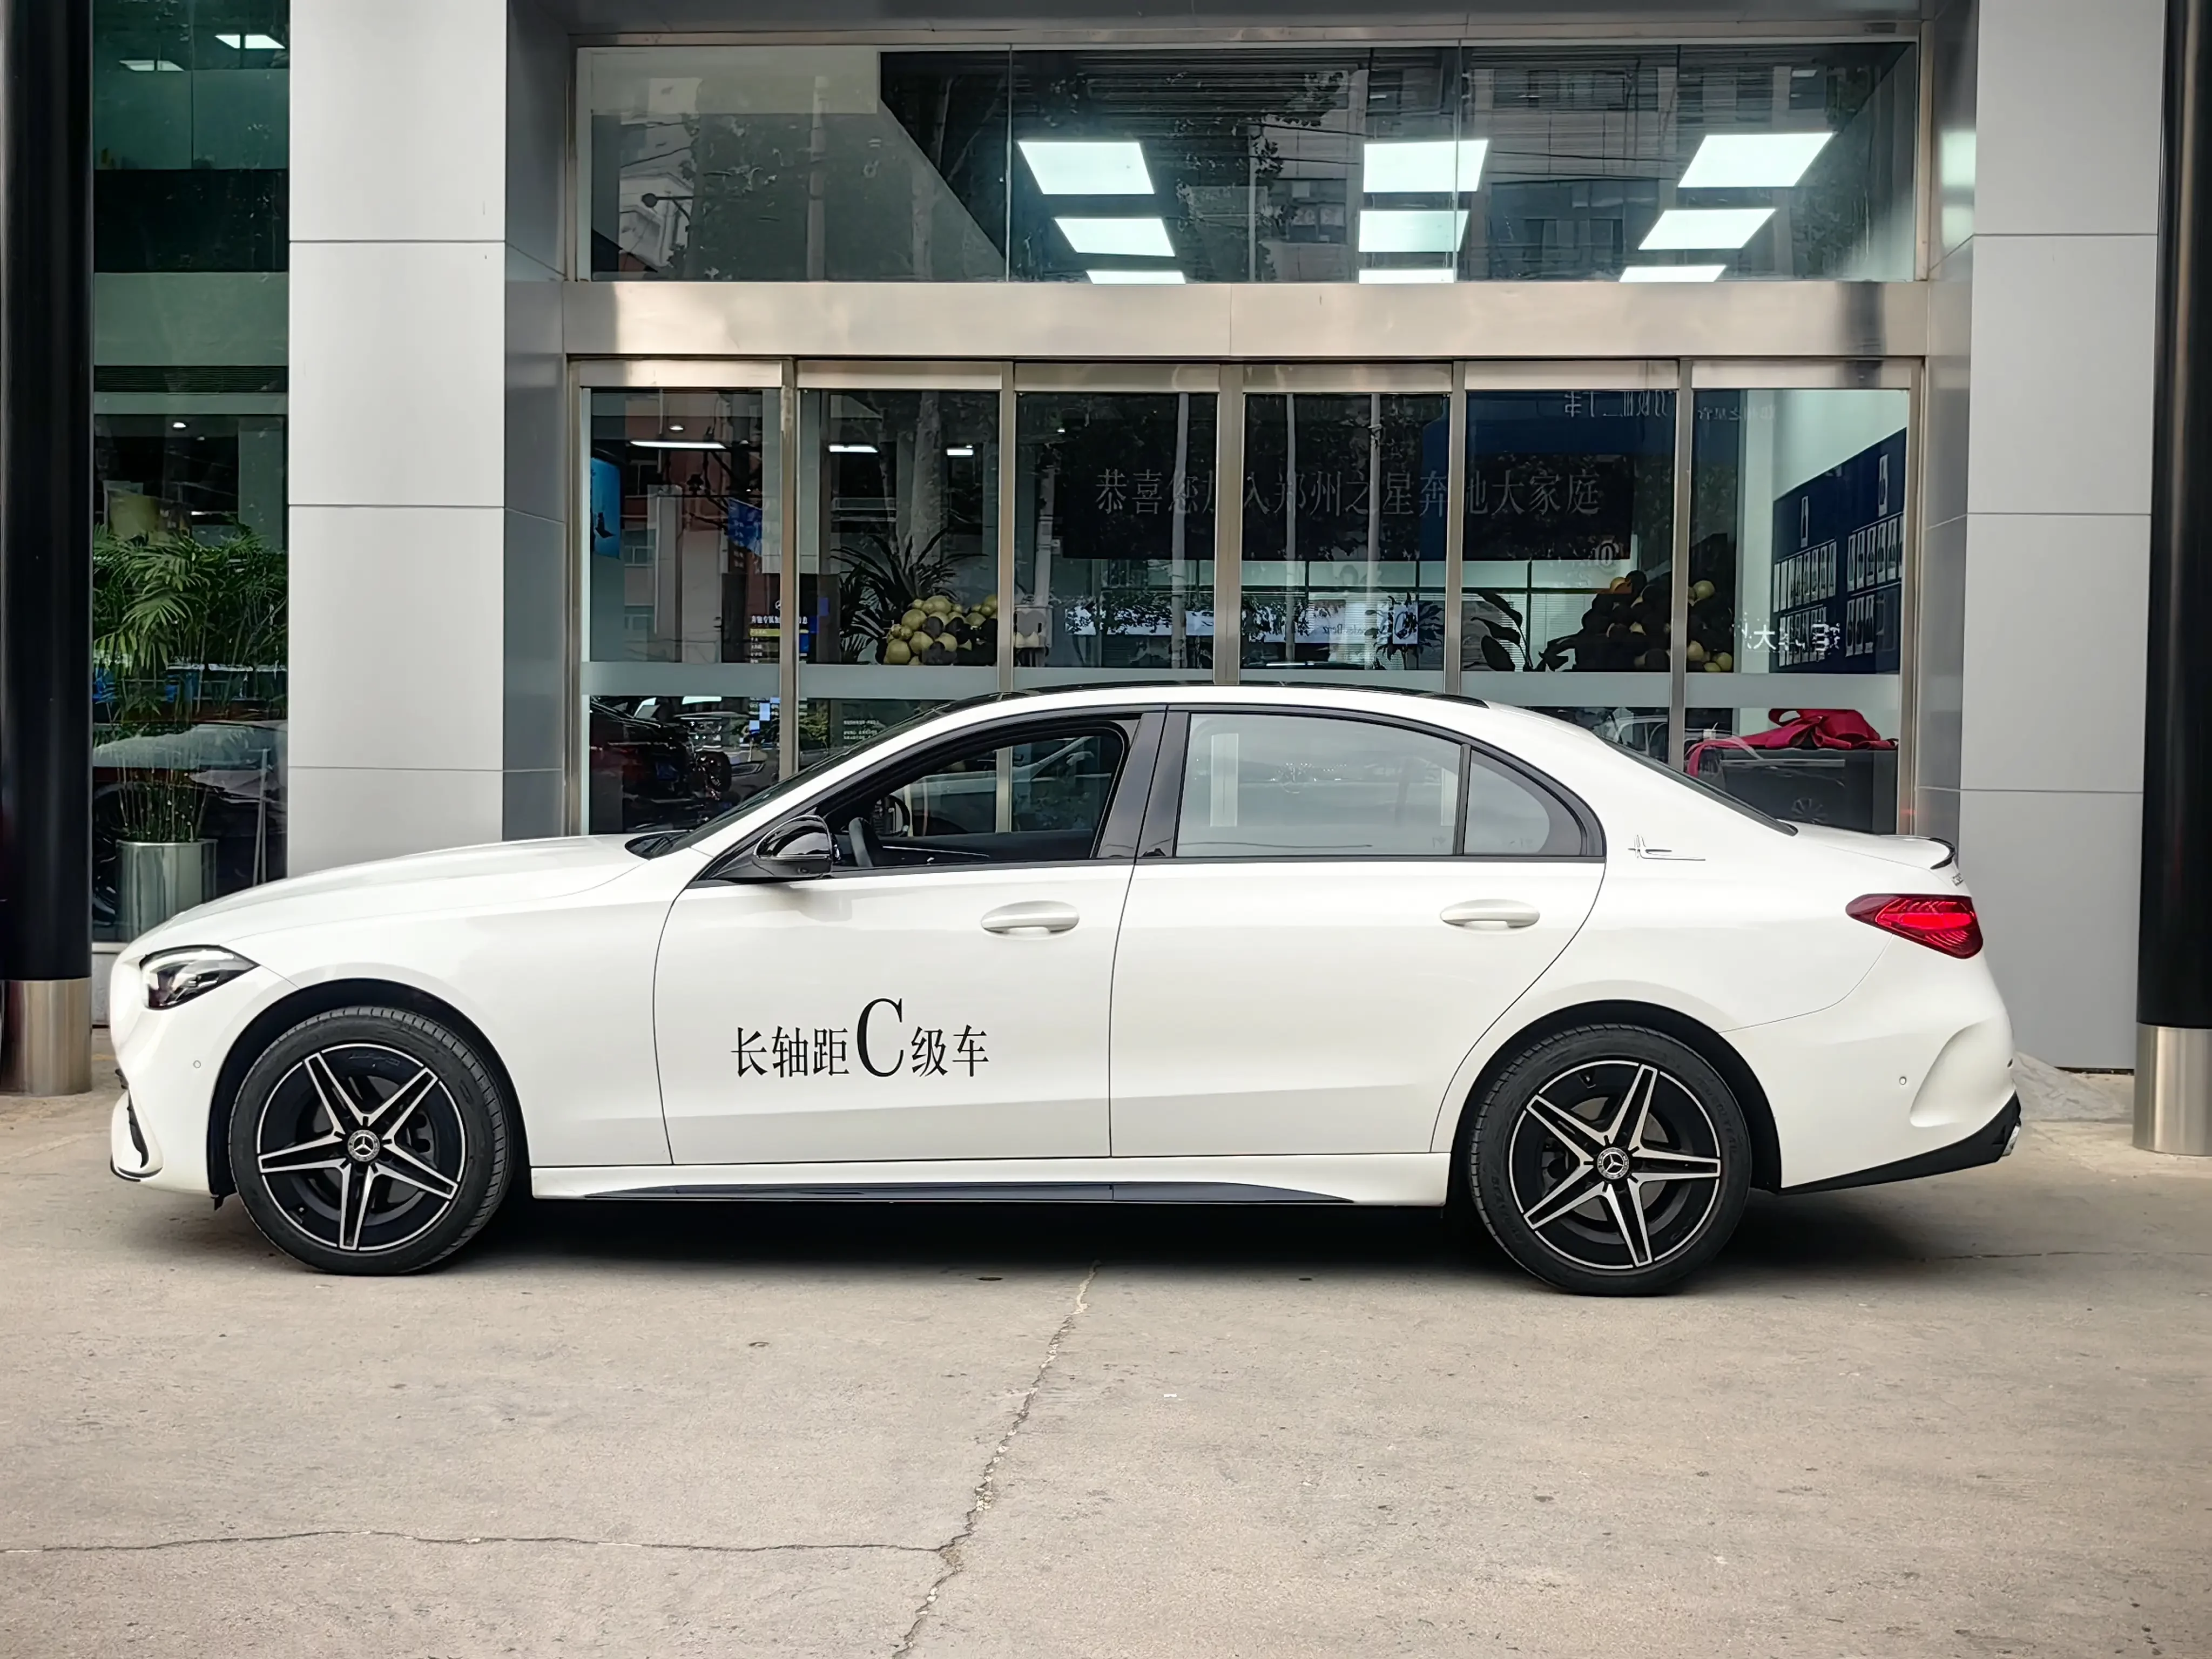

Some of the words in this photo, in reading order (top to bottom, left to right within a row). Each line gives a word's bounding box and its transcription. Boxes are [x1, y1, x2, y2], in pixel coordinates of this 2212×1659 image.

[731, 998, 989, 1077] 长轴距C级车
